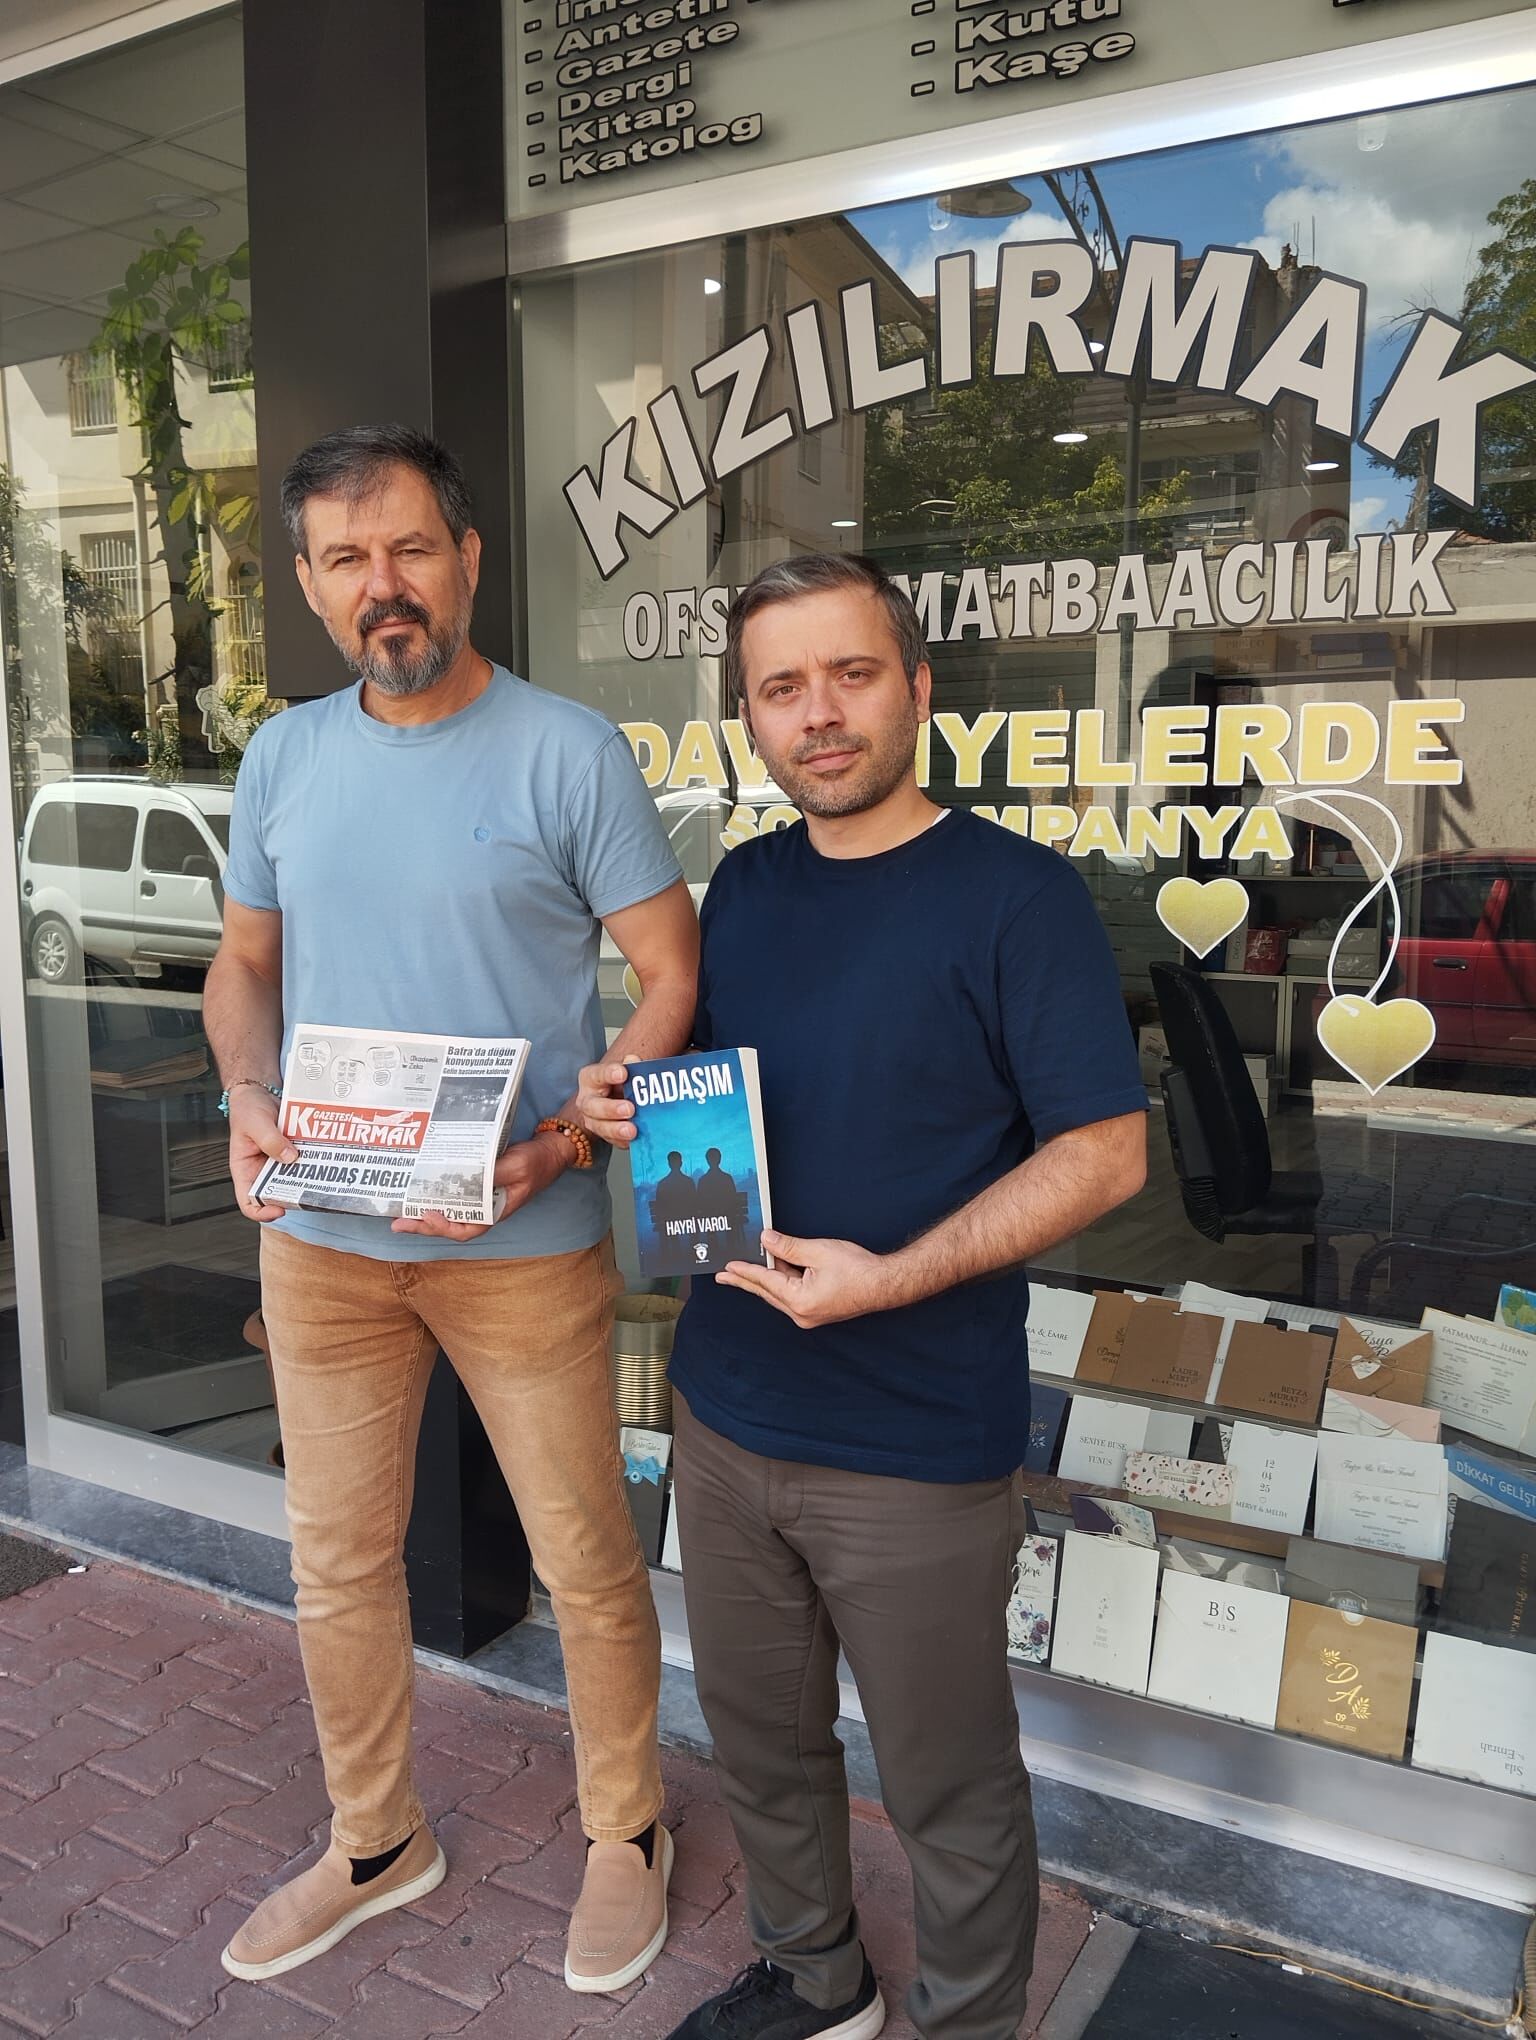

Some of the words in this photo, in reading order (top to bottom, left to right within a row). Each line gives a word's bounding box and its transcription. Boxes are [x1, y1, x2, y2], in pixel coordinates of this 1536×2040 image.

[955, 0, 1121, 52] Kutu
[557, 21, 740, 88] Gazete
[955, 32, 1136, 93] Kaşe
[558, 60, 693, 121] Dergi
[559, 98, 696, 152] Kitap
[560, 112, 763, 184] Katolog
[562, 234, 1536, 581] KIZILIRMAK
[623, 584, 738, 661] OFS
[887, 528, 1457, 644] MATBAACILIK
[618, 698, 1465, 788] DAVYELERDE
[719, 804, 804, 851] SO
[970, 805, 1294, 861] MPANYA
[445, 1056, 494, 1067] konvoyunda
[495, 1057, 513, 1066] kaza
[447, 1046, 486, 1057] Bafra'da
[632, 1063, 734, 1107] GADAŞIM
[287, 1105, 420, 1146] KIZILIRMAK
[277, 1162, 359, 1185] VATANDAŞ
[333, 1152, 366, 1164] HAYVAN
[366, 1154, 416, 1167] BARINAĞINA
[666, 1217, 697, 1236] HAYRİ
[697, 1215, 732, 1233] VAROL
[1265, 1459, 1275, 1469] 12
[1456, 1461, 1496, 1487] DİKKAT
[1335, 1712, 1347, 1722] 09
